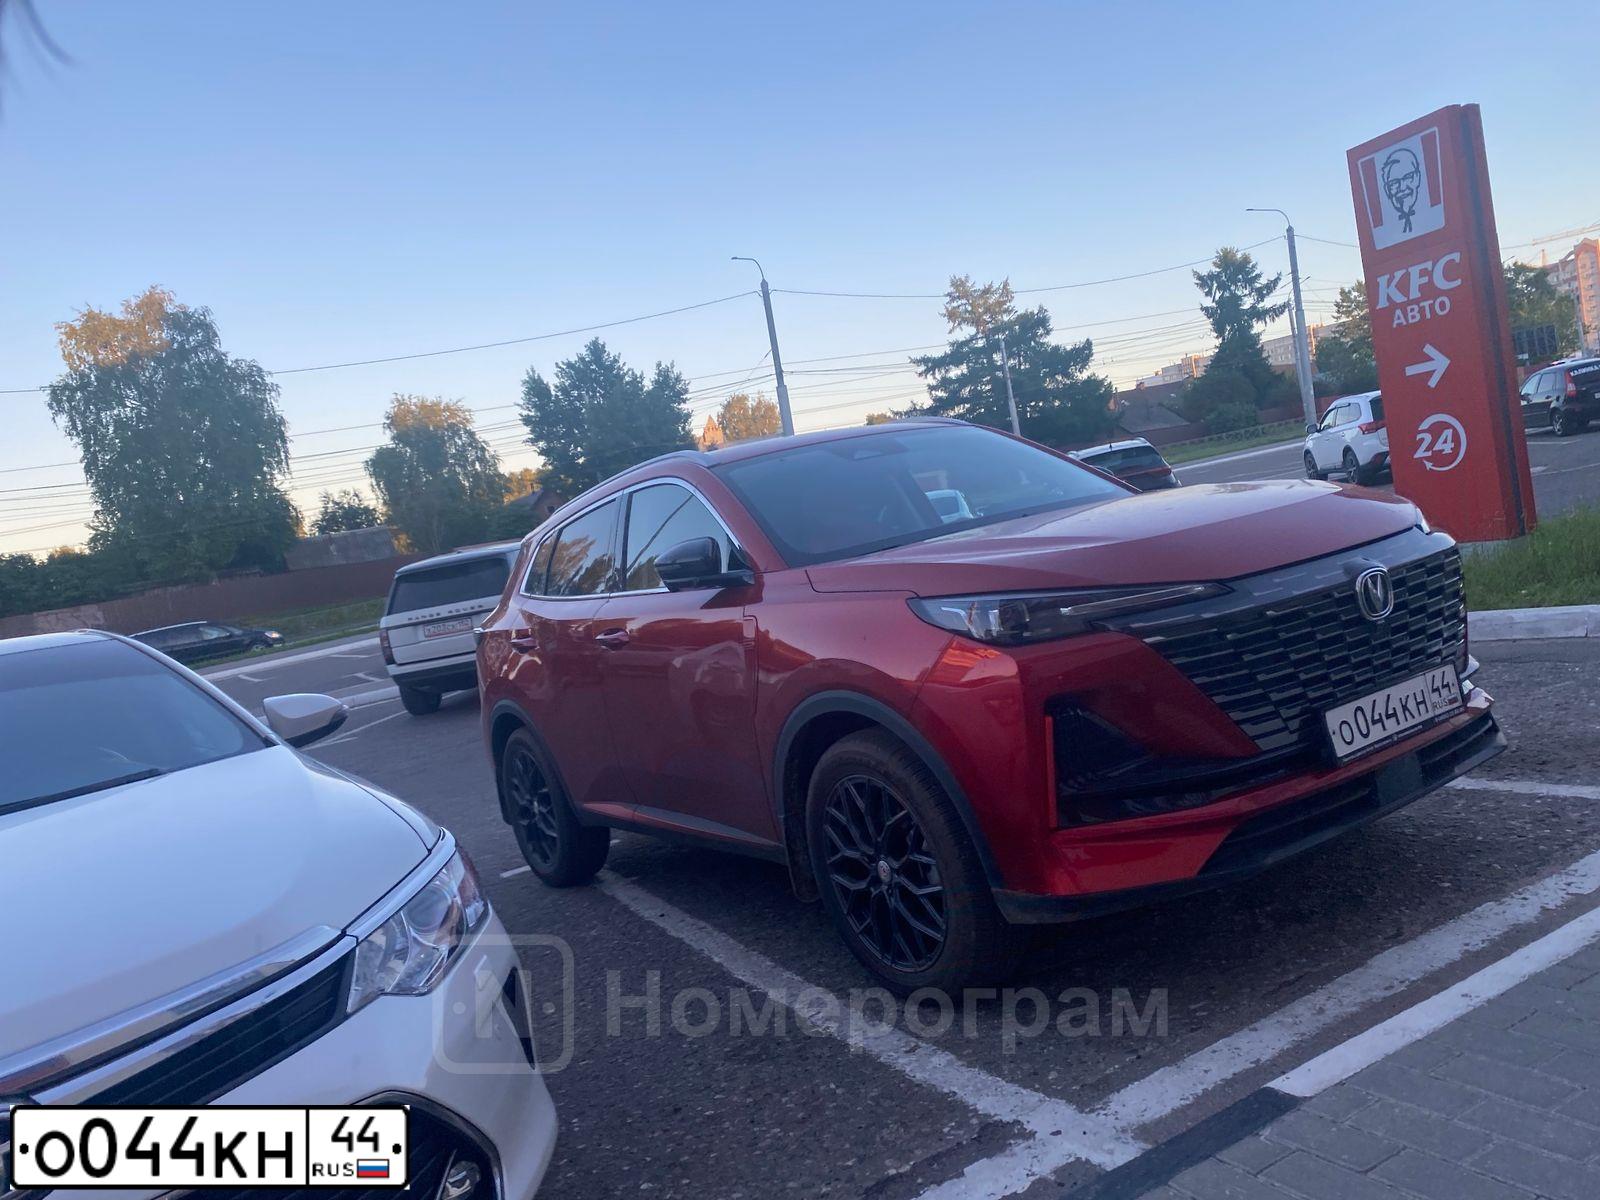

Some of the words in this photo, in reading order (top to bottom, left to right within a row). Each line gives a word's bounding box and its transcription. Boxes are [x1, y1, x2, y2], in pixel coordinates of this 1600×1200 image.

[1376, 252, 1462, 310] KFC
[1392, 295, 1451, 328] АВТО
[1413, 429, 1454, 459] 24
[1431, 671, 1452, 698] 44
[1432, 700, 1450, 711] RUS
